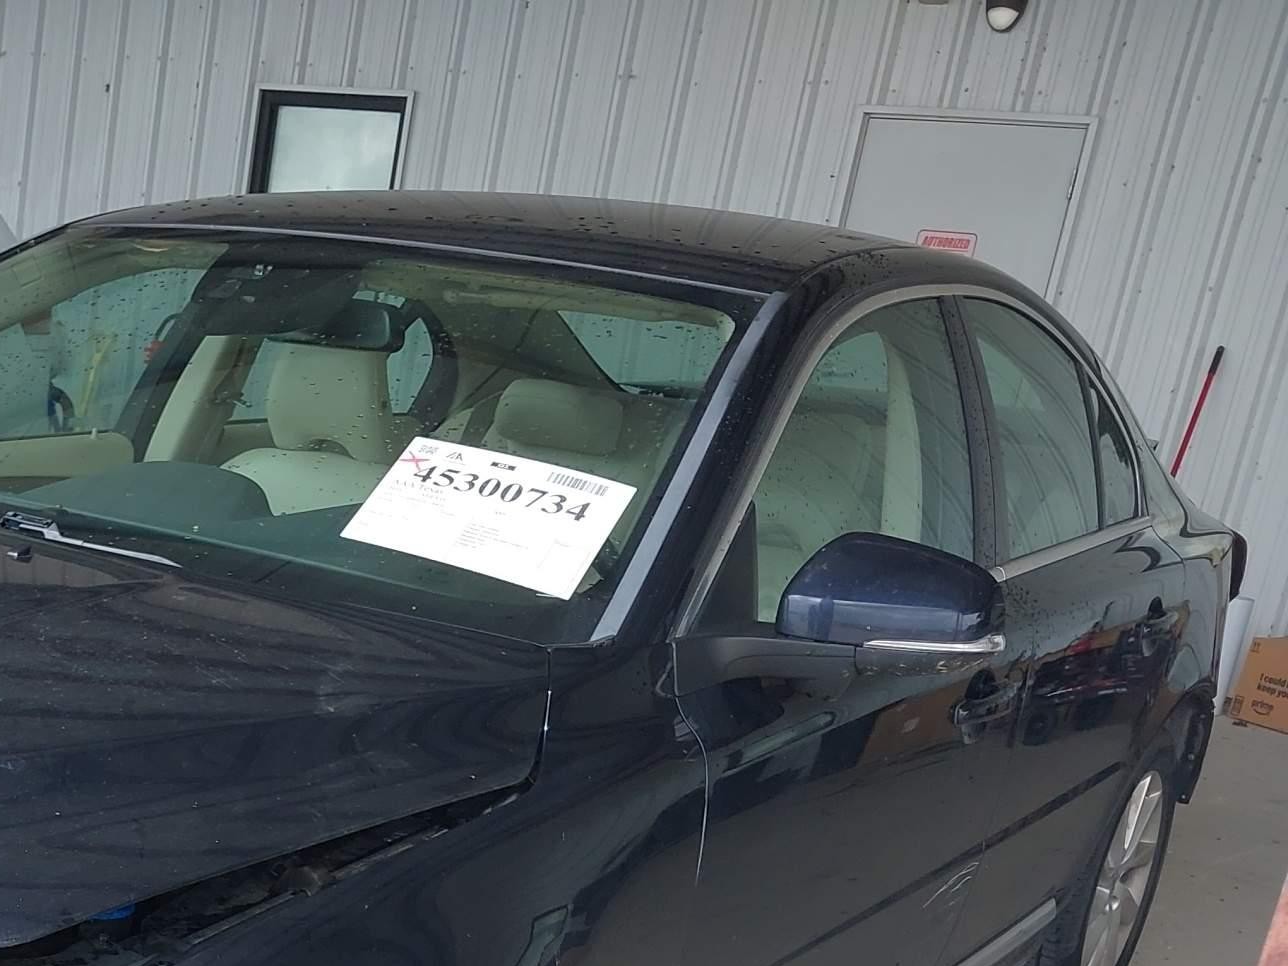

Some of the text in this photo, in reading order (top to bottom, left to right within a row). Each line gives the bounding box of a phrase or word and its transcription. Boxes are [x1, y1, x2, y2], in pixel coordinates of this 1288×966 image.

[921, 236, 970, 250] AUTHORIZED
[413, 465, 592, 522] 45300734
[1264, 675, 1287, 688] could
[1257, 683, 1277, 697] keep
[1250, 700, 1274, 712] prime
